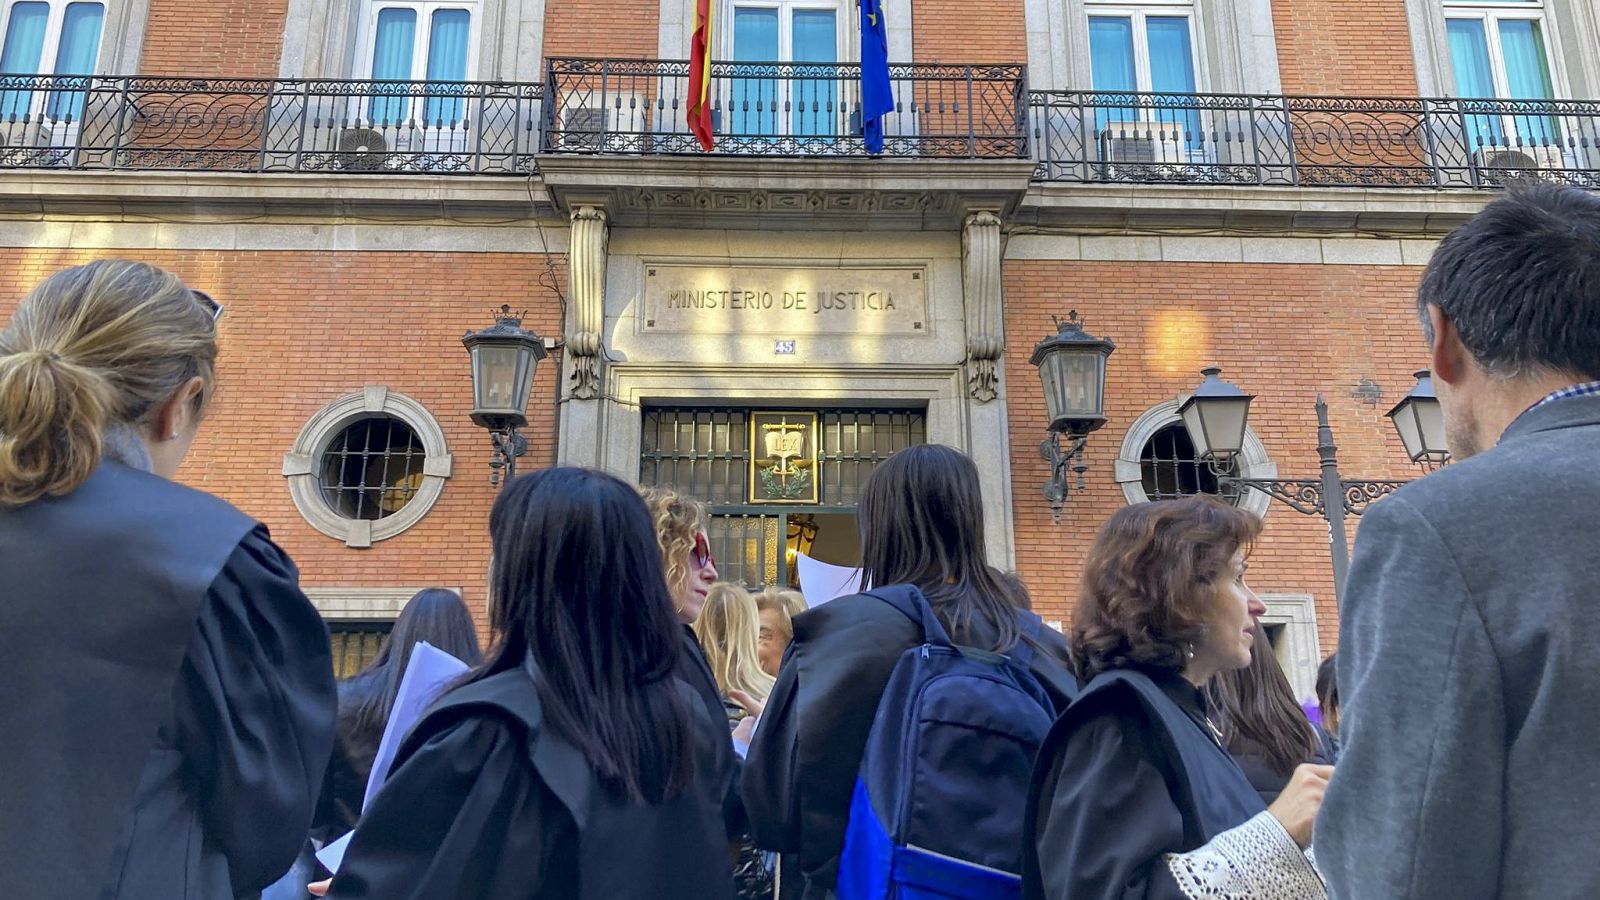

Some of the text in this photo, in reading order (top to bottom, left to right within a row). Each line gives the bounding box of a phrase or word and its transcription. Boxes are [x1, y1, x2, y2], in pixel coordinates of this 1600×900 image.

[667, 290, 896, 314] MINISTERIO DE JUSTICIA
[775, 341, 795, 353] 45
[774, 437, 798, 452] LEX
